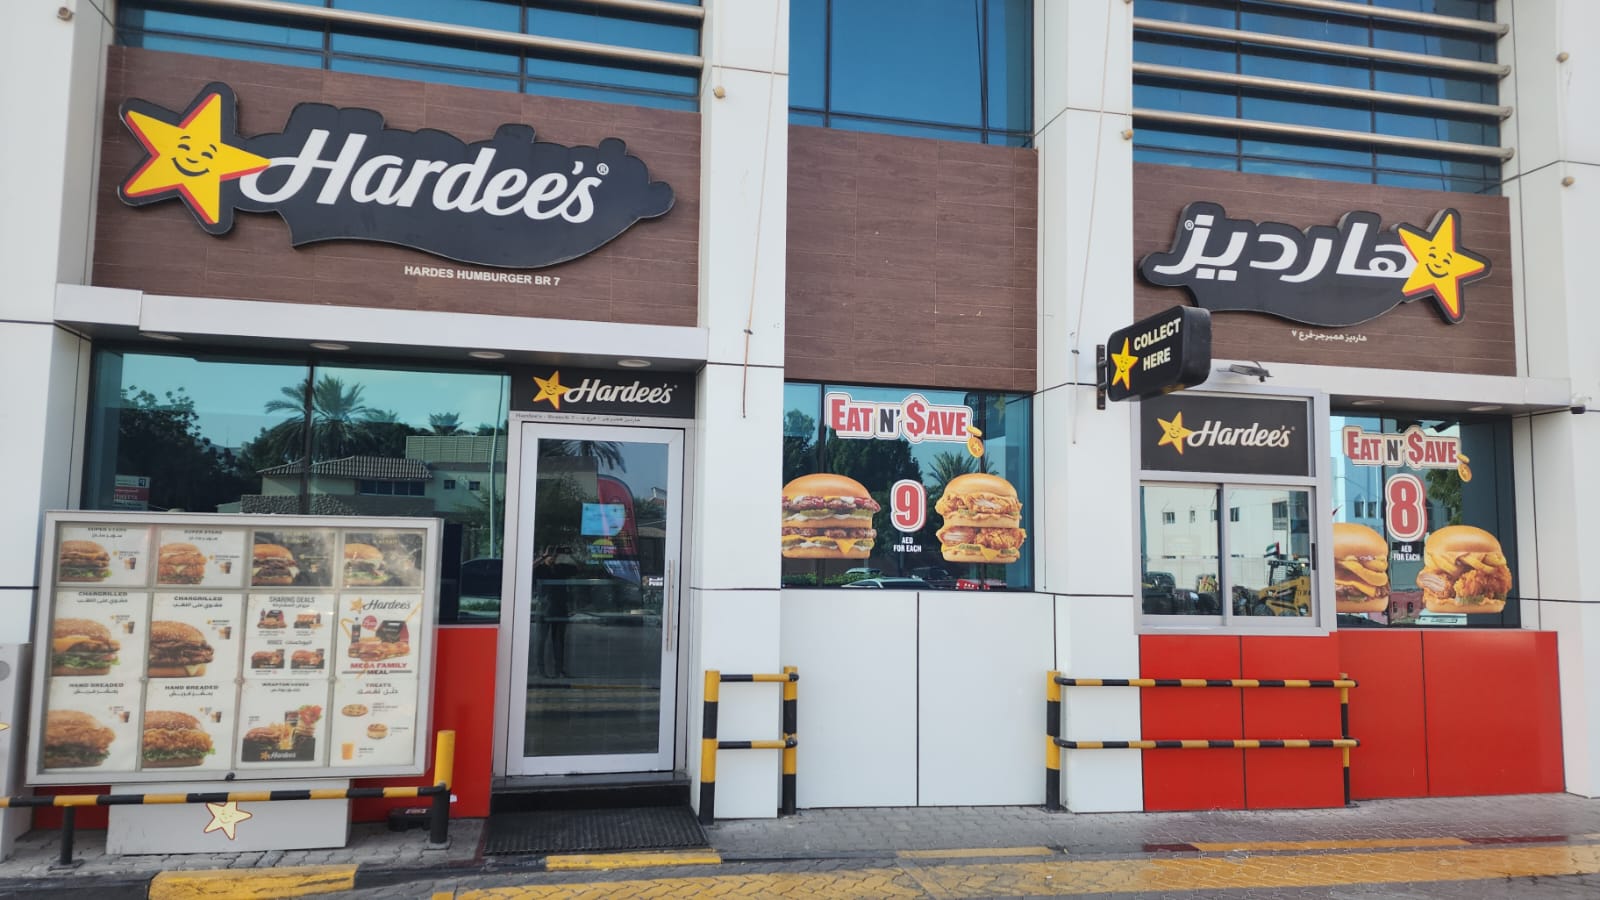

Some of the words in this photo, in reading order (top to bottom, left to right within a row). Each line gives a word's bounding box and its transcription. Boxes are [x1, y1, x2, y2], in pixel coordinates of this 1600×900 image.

[239, 128, 602, 223] Hardee's
[1154, 213, 1418, 282] هارديز
[404, 265, 454, 279] HARDES
[457, 269, 532, 285] HUMBURGER
[534, 275, 551, 286] BR
[554, 277, 561, 286] 7
[1133, 318, 1181, 351] COLLECT
[1143, 347, 1171, 371] HERE
[563, 378, 674, 404] Hardee's
[831, 398, 874, 432] EAT
[879, 408, 900, 433] N'
[906, 400, 967, 437] $AVE
[1187, 420, 1292, 448] Hardee's
[1347, 431, 1382, 460] EAT
[1386, 439, 1404, 462] N'
[1407, 432, 1457, 464] $AVE
[893, 482, 922, 529] 9
[1388, 476, 1423, 538] 8
[893, 544, 905, 552] FOR
[906, 544, 922, 553] EACH
[901, 536, 913, 545] AED
[1401, 545, 1412, 553] AED
[1393, 553, 1404, 561] FOR
[1405, 553, 1421, 561] EACH
